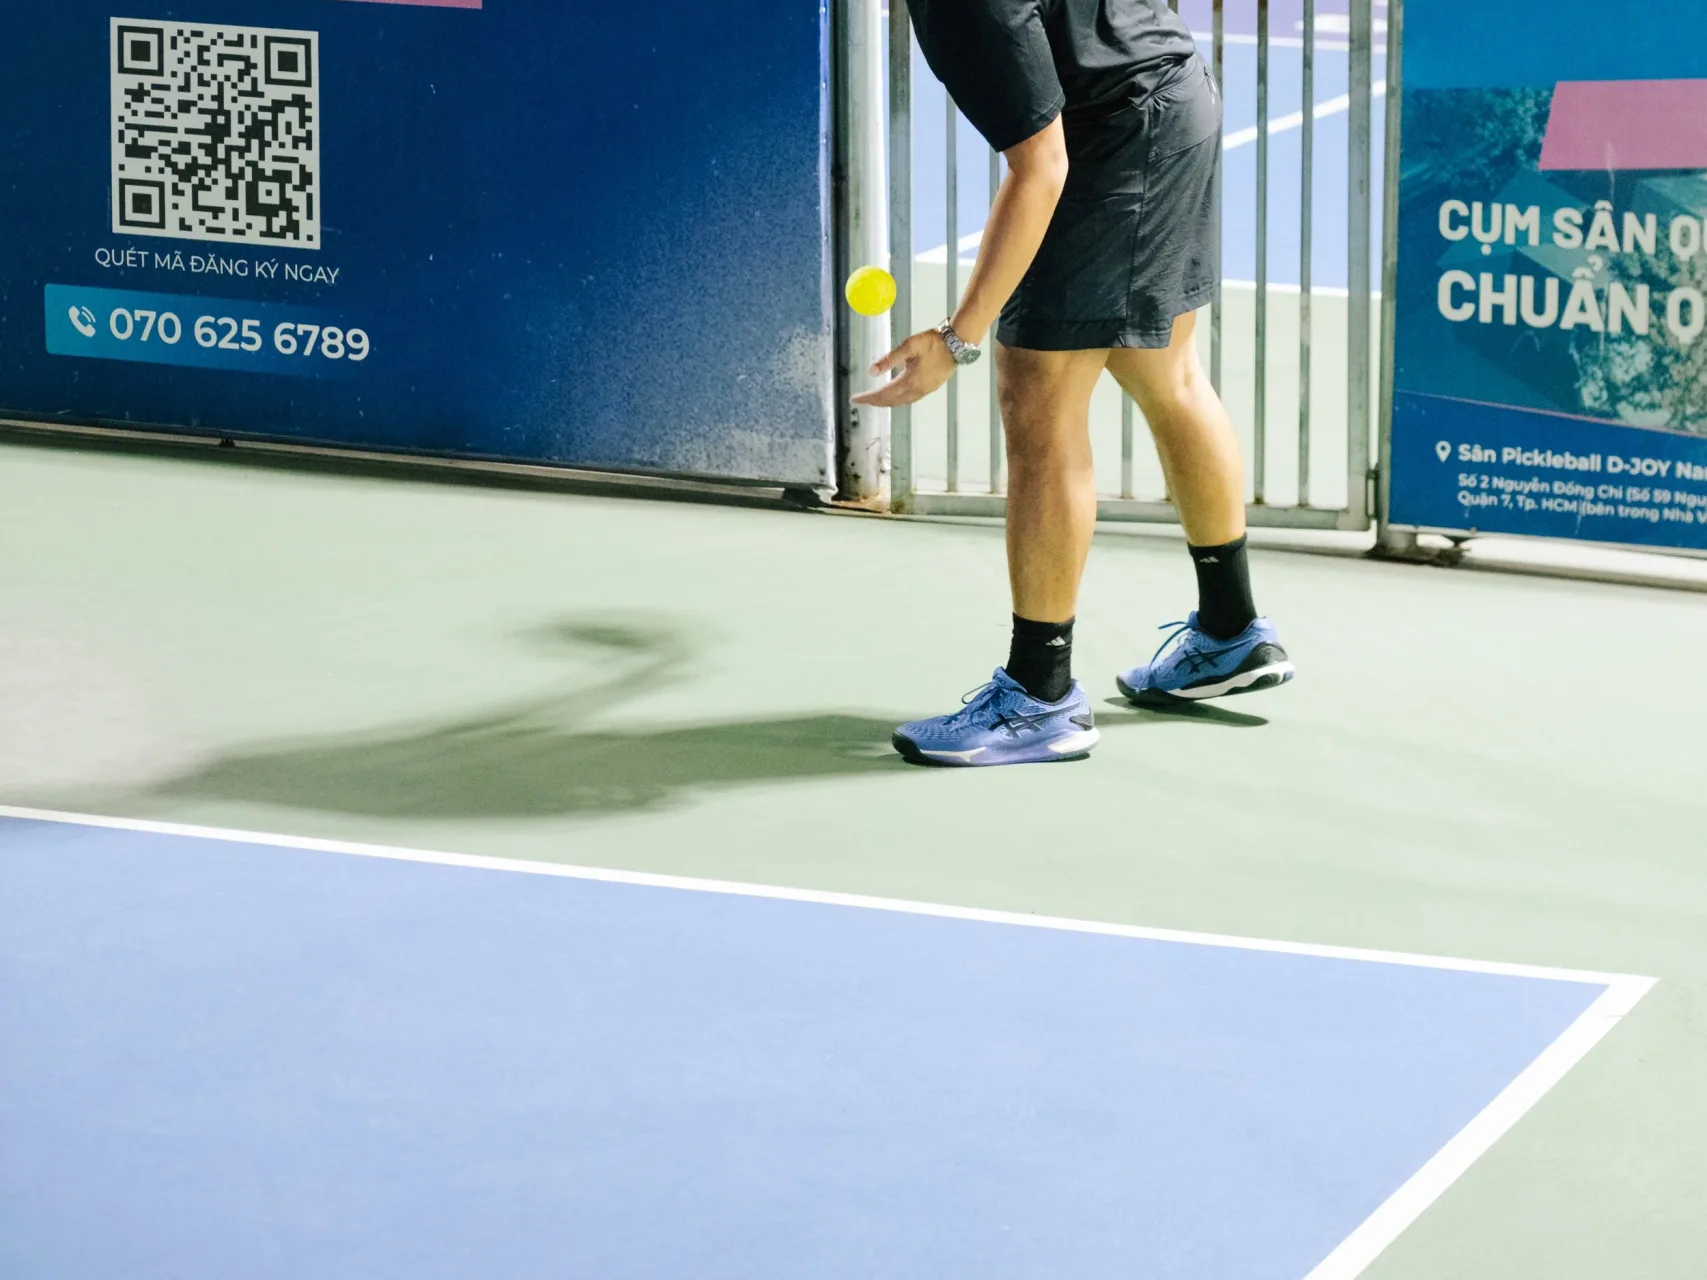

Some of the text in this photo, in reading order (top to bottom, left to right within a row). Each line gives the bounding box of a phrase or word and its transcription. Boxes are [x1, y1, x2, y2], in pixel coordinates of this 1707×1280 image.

[1438, 199, 1707, 262] CỤM SÂN Q
[94, 247, 340, 285] QUÉT MÃ ĐĂNG KÝ NGAY
[1437, 255, 1650, 336] CHUẨN
[109, 307, 370, 361] 070 625 6789
[1457, 443, 1497, 463] Sân
[1501, 446, 1602, 472] Pickleball
[1606, 455, 1672, 477] D-JOY
[1479, 475, 1490, 489] 2
[1541, 497, 1577, 512] HCM
[1617, 504, 1660, 523] trong
